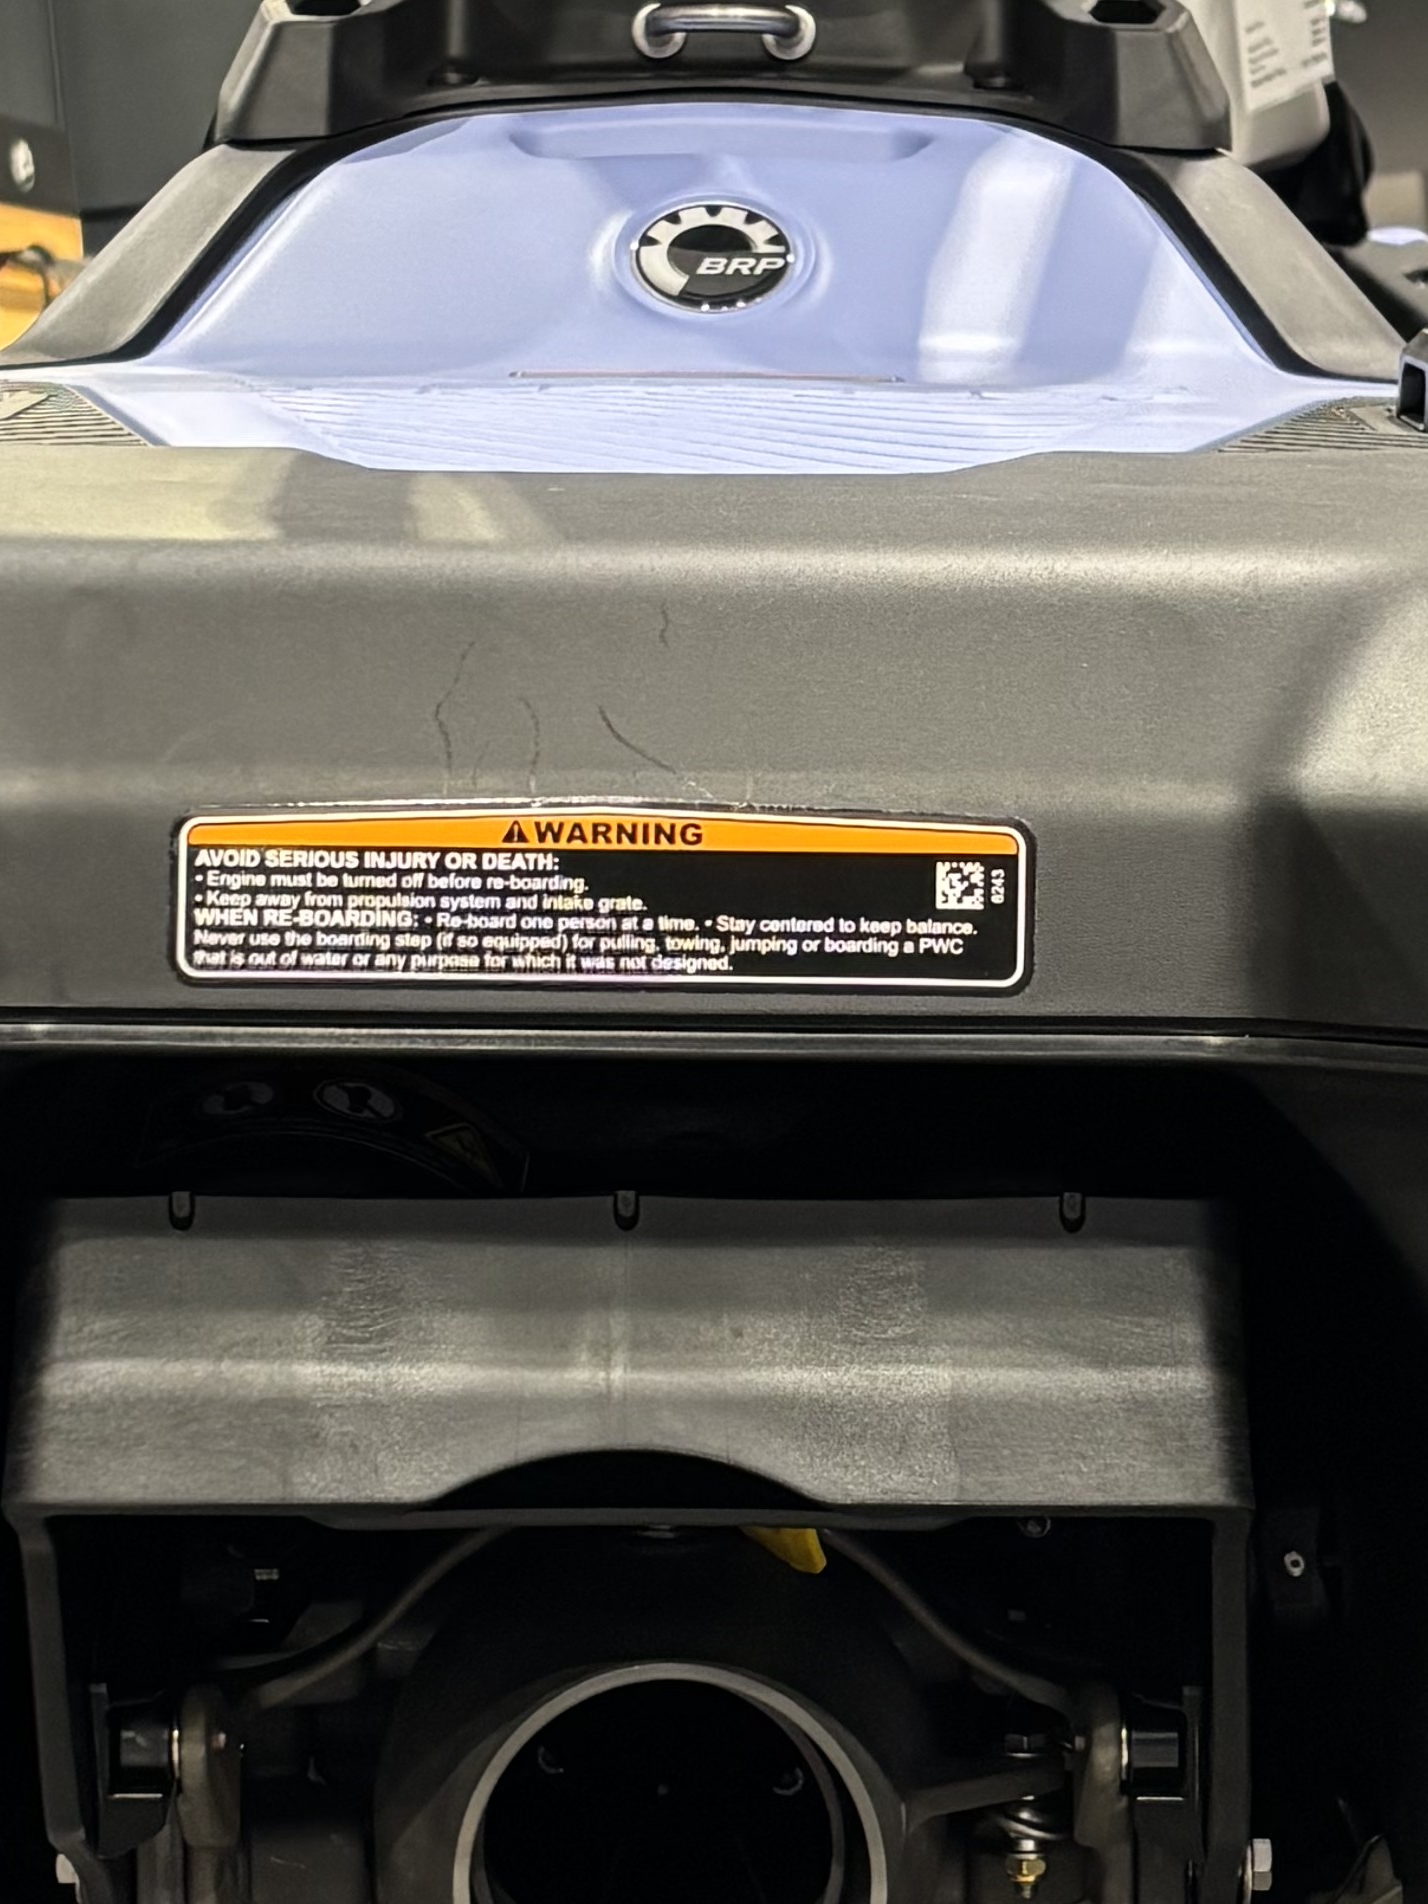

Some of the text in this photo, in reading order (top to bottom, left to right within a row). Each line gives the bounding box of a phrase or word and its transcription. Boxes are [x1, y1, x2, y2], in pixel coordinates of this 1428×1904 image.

[695, 256, 786, 276] BRP
[533, 821, 704, 846] WARNING
[194, 848, 560, 871] AVOID SERIOUS INJURY OR DEATH:
[207, 870, 589, 892] Engine must be turned off before re-boarding.
[207, 891, 648, 914] Keep away from propulsion system and intake grate.
[194, 908, 978, 937] WHEN RE-BOARDING: Re-board one person at a time. Stay centered to keep balance.
[193, 930, 246, 946] Never
[249, 933, 281, 946] use
[284, 931, 313, 947] the
[316, 932, 391, 950] boarding
[394, 932, 432, 950] step
[436, 932, 454, 950] (if
[457, 934, 478, 948] so
[482, 933, 569, 952] equipped)
[572, 935, 596, 949] for
[729, 936, 798, 955] jumping
[802, 940, 821, 953] or
[824, 937, 899, 957] boarding
[903, 941, 915, 954] a
[919, 939, 964, 954] PWC
[193, 950, 733, 974] that is out of water or any purpose for which it was not designed.
